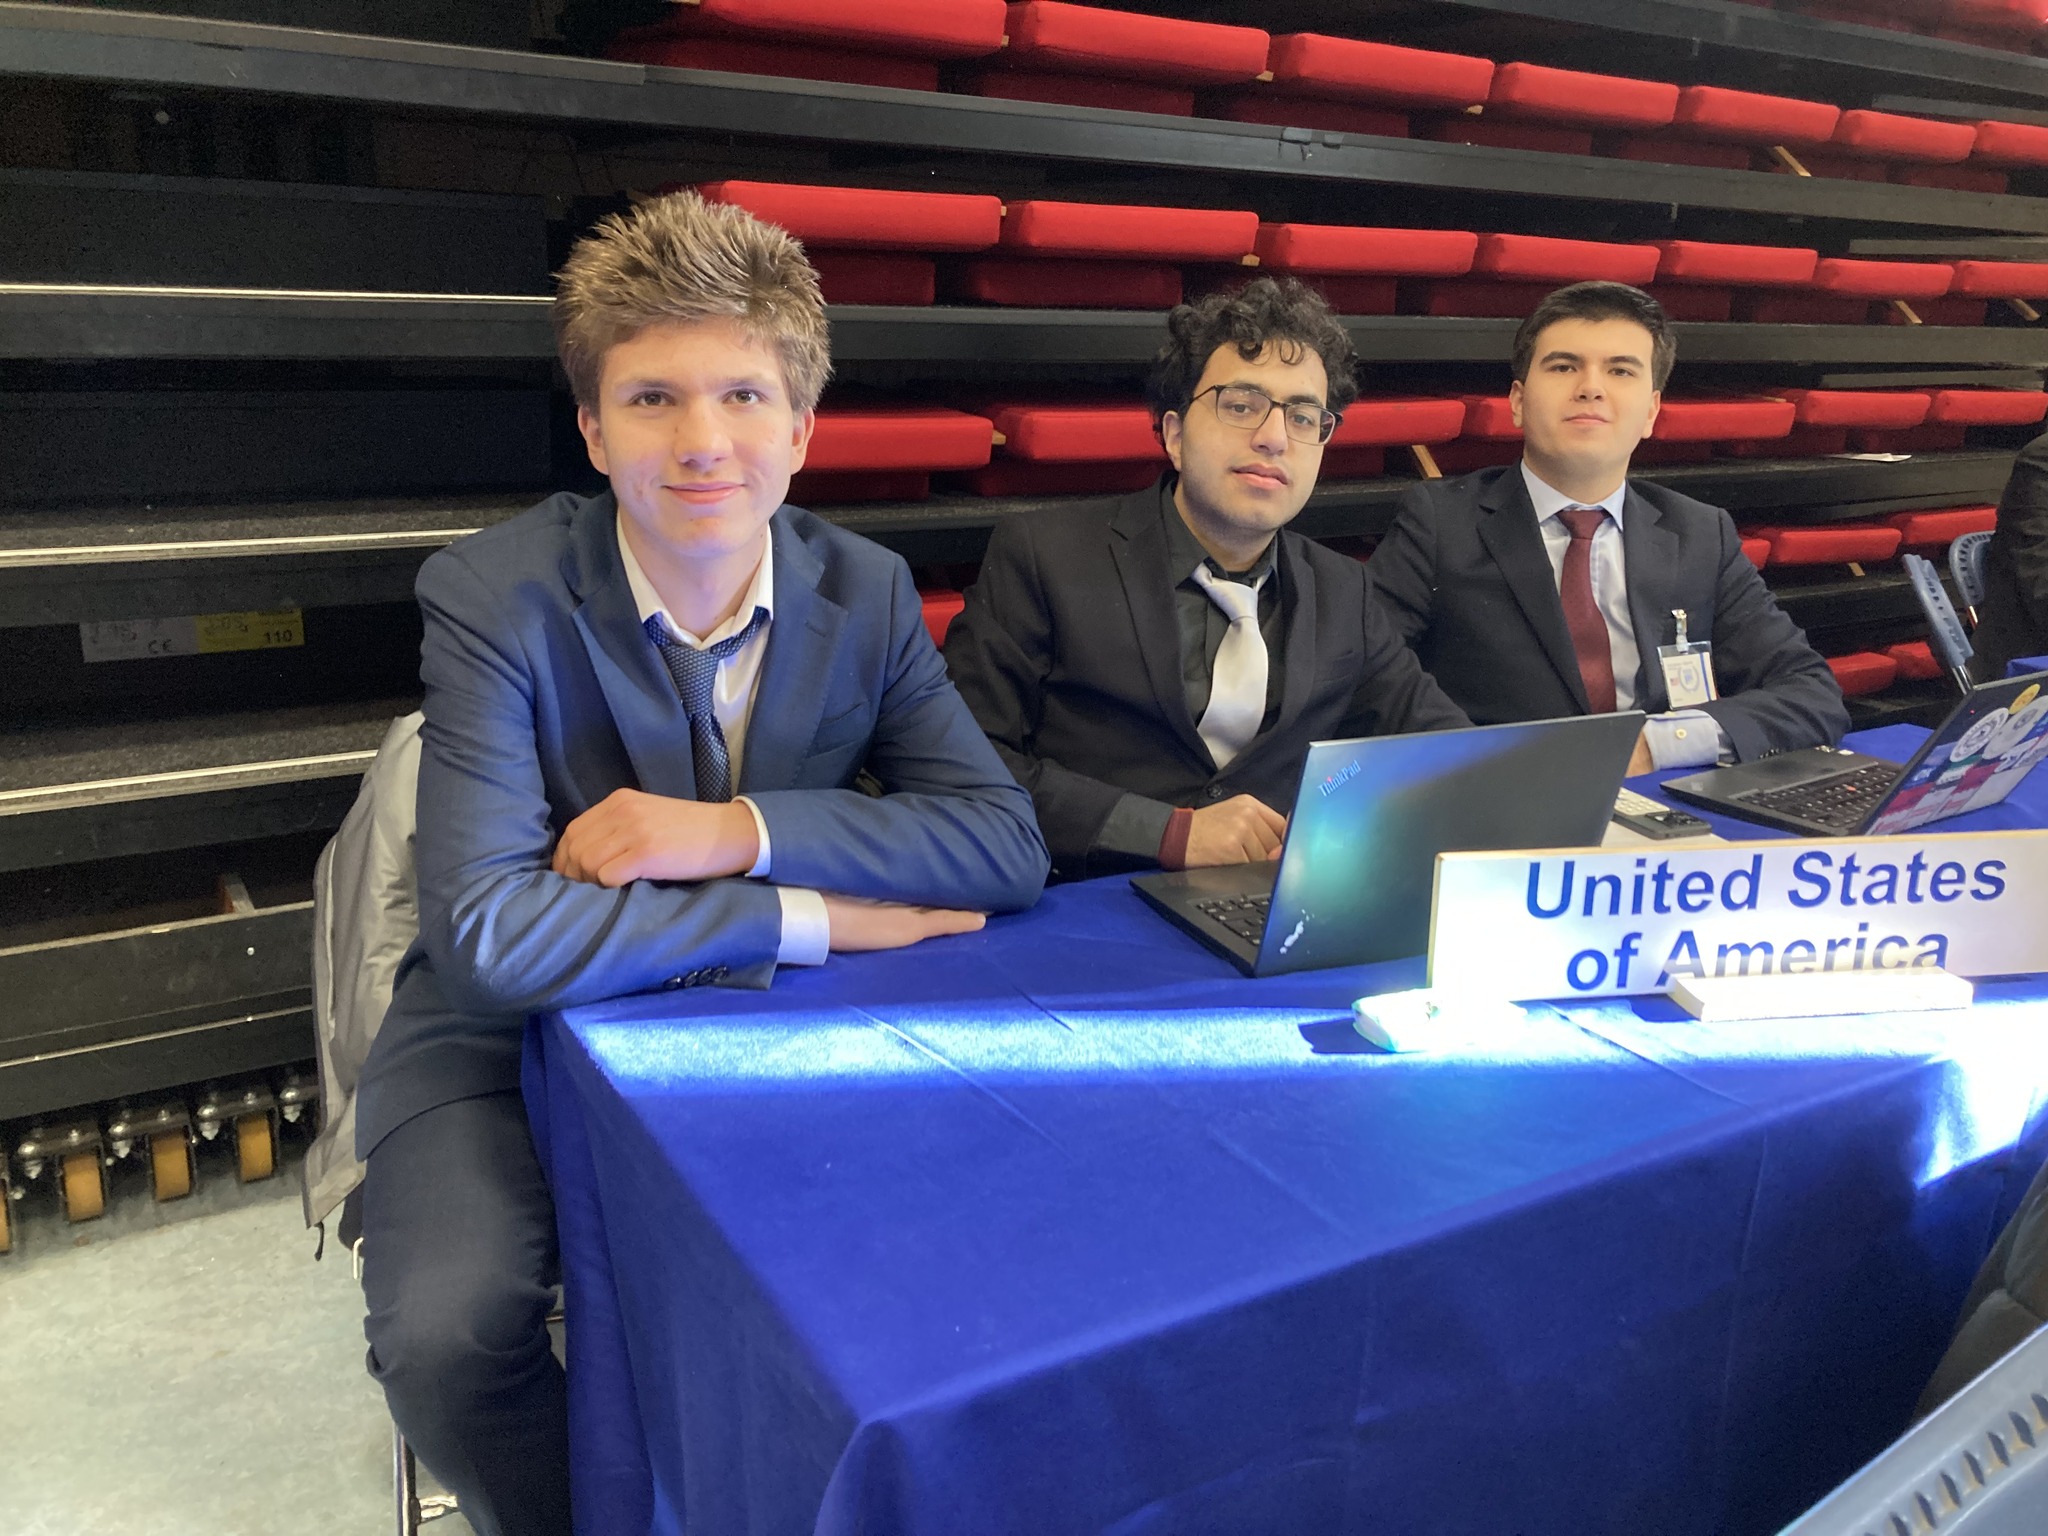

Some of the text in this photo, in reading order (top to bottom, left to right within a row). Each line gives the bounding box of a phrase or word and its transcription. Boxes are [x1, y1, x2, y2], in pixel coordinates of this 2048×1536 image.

[265, 629, 294, 645] 110
[1317, 759, 1362, 797] ThinkPad
[1525, 849, 2007, 919] United States
[1566, 922, 1950, 992] of America
